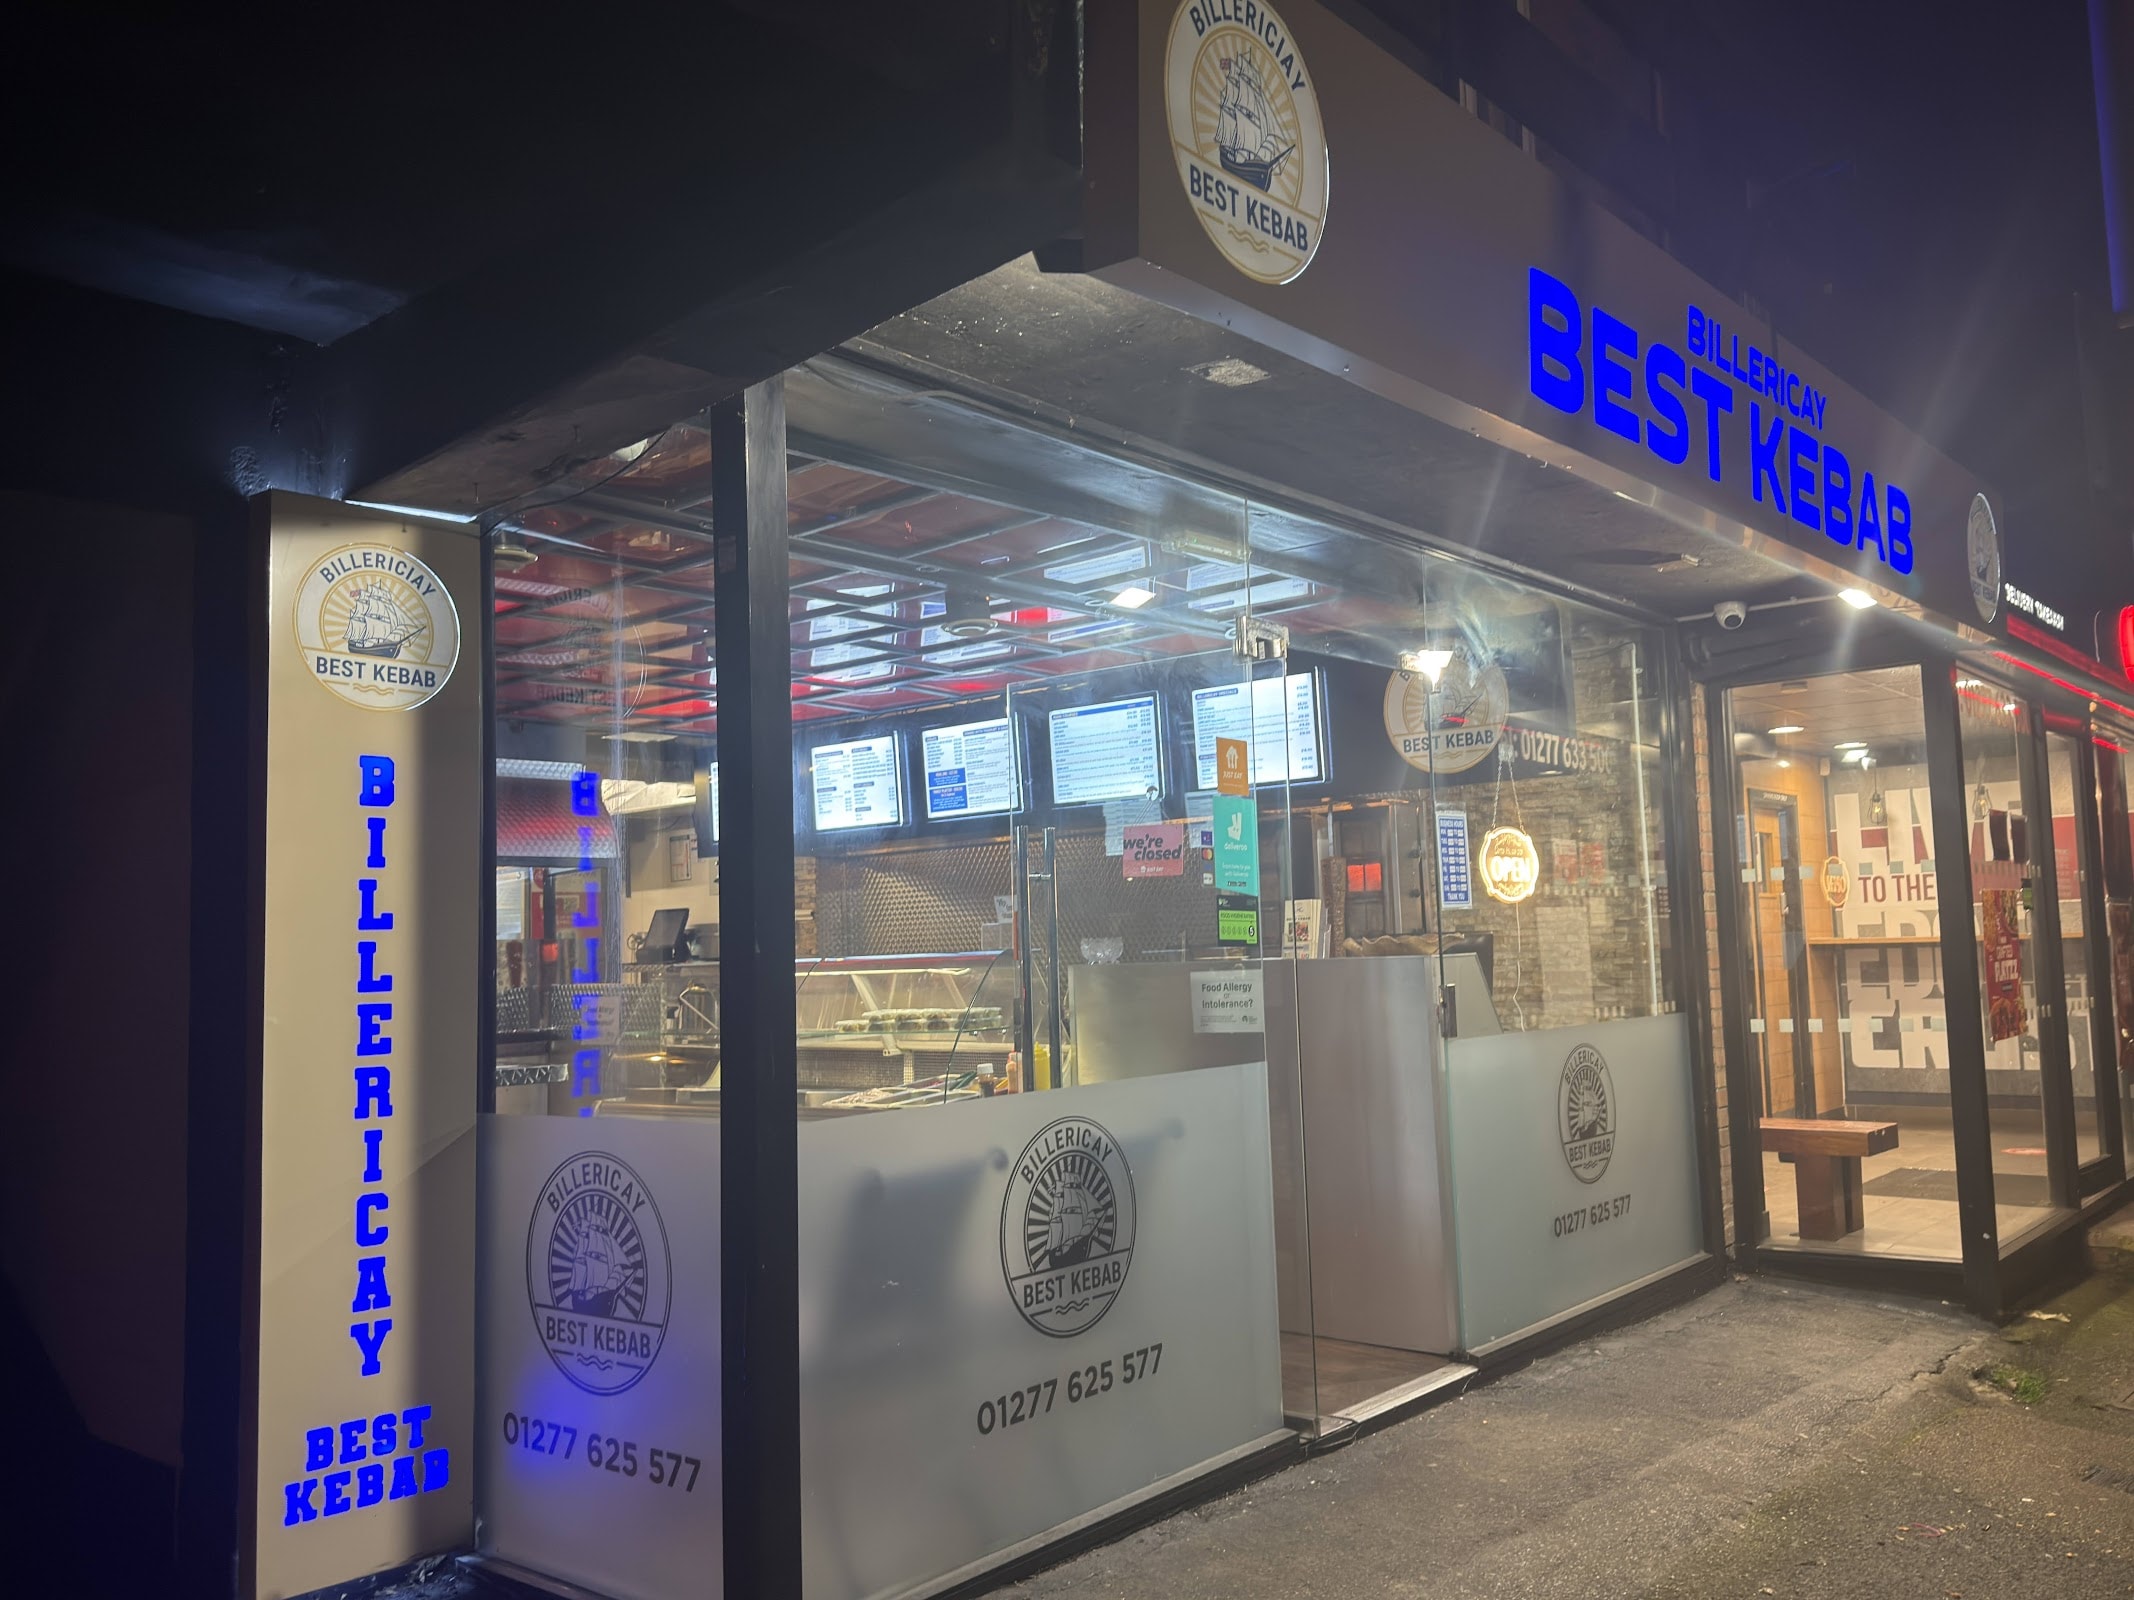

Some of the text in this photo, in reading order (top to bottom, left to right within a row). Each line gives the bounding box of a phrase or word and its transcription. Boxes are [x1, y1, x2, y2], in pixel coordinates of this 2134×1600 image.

[1189, 0, 1306, 92] BILLERICIAY
[1189, 163, 1309, 252] BEST KEBAB
[1687, 304, 1828, 430] BILLERICAY
[1528, 266, 1914, 576] BEST KEBAB
[319, 552, 437, 597] BILLERICIAY
[316, 656, 436, 688] BEST KEBAB
[1403, 736, 1440, 753] BEST
[1446, 730, 1494, 749] KEBAB
[1521, 729, 1560, 766] 01277
[1562, 738, 1587, 770] 633
[1123, 834, 1164, 850] we're
[1134, 844, 1183, 861] closed
[1490, 855, 1533, 883] OPEN
[1858, 873, 1937, 903] TO THE
[1201, 982, 1253, 993] Food Allergy
[1202, 999, 1254, 1009] Intolerance?
[350, 755, 395, 1377] BILLERICAY
[1564, 1049, 1605, 1086] BILLERICAY
[1020, 1126, 1114, 1186] BILLERICAY
[1568, 1138, 1612, 1163] BEST KEBAB
[546, 1162, 647, 1216] BILLERICAY
[1553, 1194, 1632, 1238] 01277 625 577
[1023, 1261, 1122, 1309] BEST KEBAB
[545, 1316, 652, 1360] BEST KEBAB
[976, 1343, 1164, 1436] 01277 625 577
[305, 1405, 433, 1472] BEST
[503, 1412, 702, 1493] 01277 625 577
[283, 1447, 451, 1528] KEBAB
